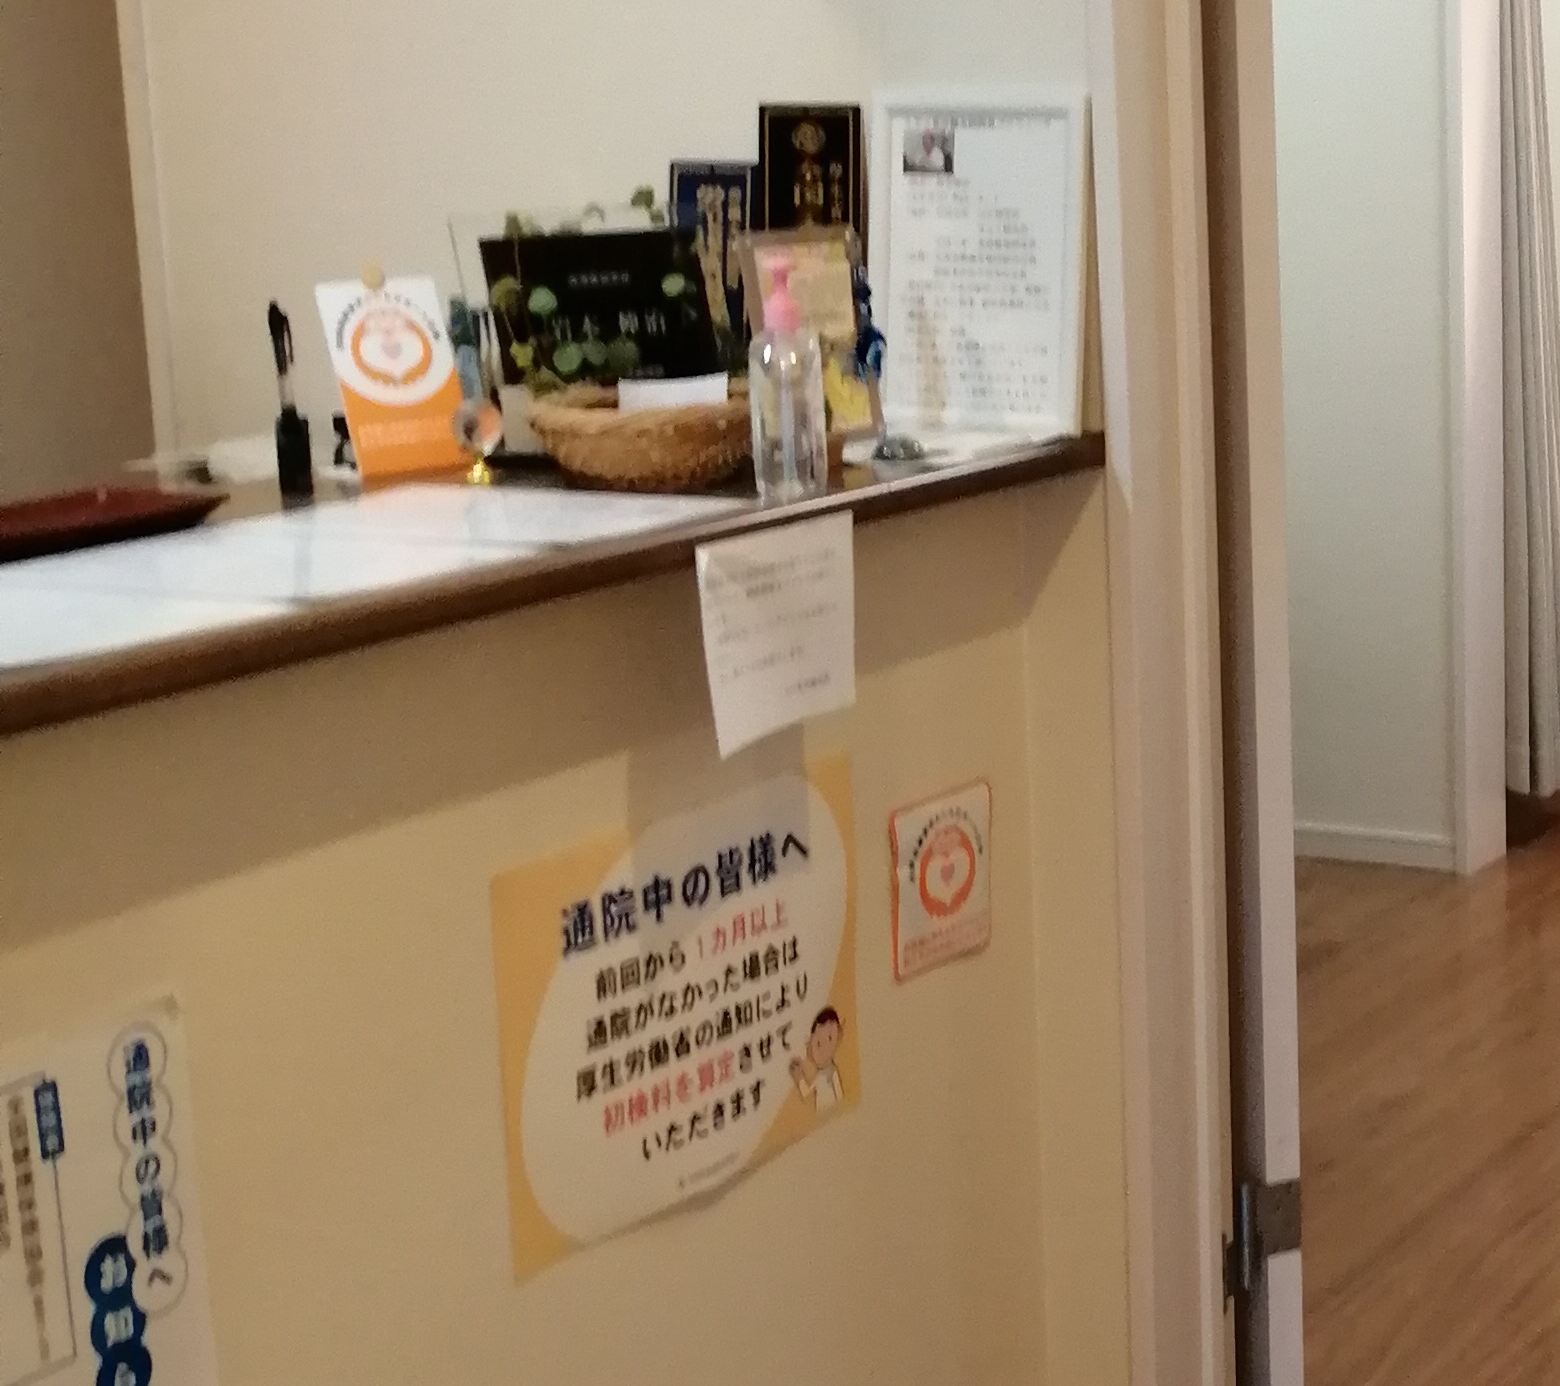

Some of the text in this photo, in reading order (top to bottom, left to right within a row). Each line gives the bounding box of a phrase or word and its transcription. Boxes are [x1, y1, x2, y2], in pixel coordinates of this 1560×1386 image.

[561, 831, 809, 959] 通院中の皆様へ
[576, 971, 808, 1104] 厚生労働省の通知により
[586, 934, 799, 1054] 通院がなかった場合は
[641, 1078, 766, 1161] いただきます
